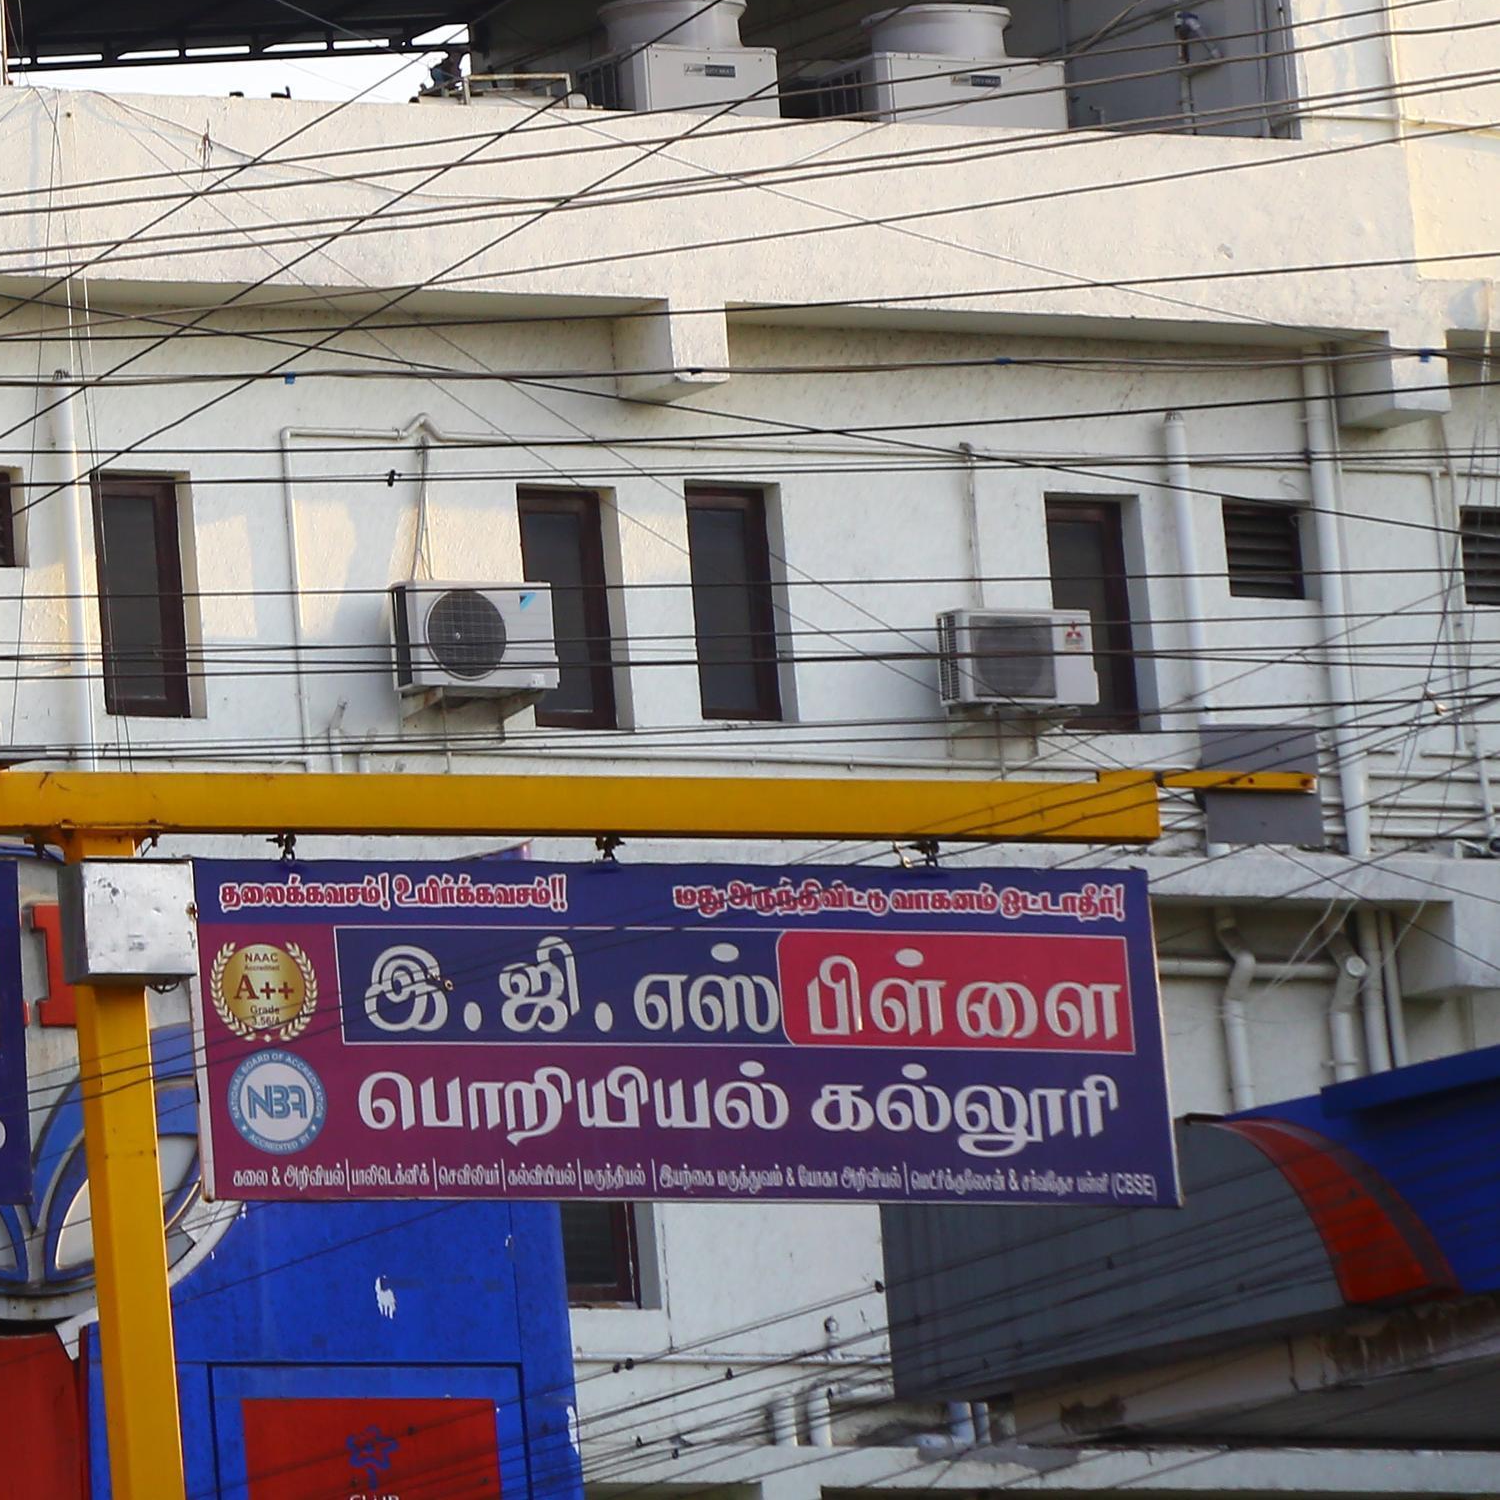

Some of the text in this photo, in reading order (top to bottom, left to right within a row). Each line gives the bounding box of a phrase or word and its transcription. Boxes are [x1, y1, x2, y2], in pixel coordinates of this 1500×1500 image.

[219, 872, 568, 913] தலைக்கவசம்! உயிர்க்கவசம்!!
[890, 883, 998, 914] வாகனம்
[245, 953, 278, 963] NAAC
[233, 974, 294, 1000] A++
[807, 947, 1121, 1041] பிள்ளை
[250, 1005, 279, 1014] Grade
[247, 1084, 307, 1119] NBA
[358, 1060, 1119, 1157] பொறியியல் கல்லூரி
[233, 1169, 268, 1186] கலை
